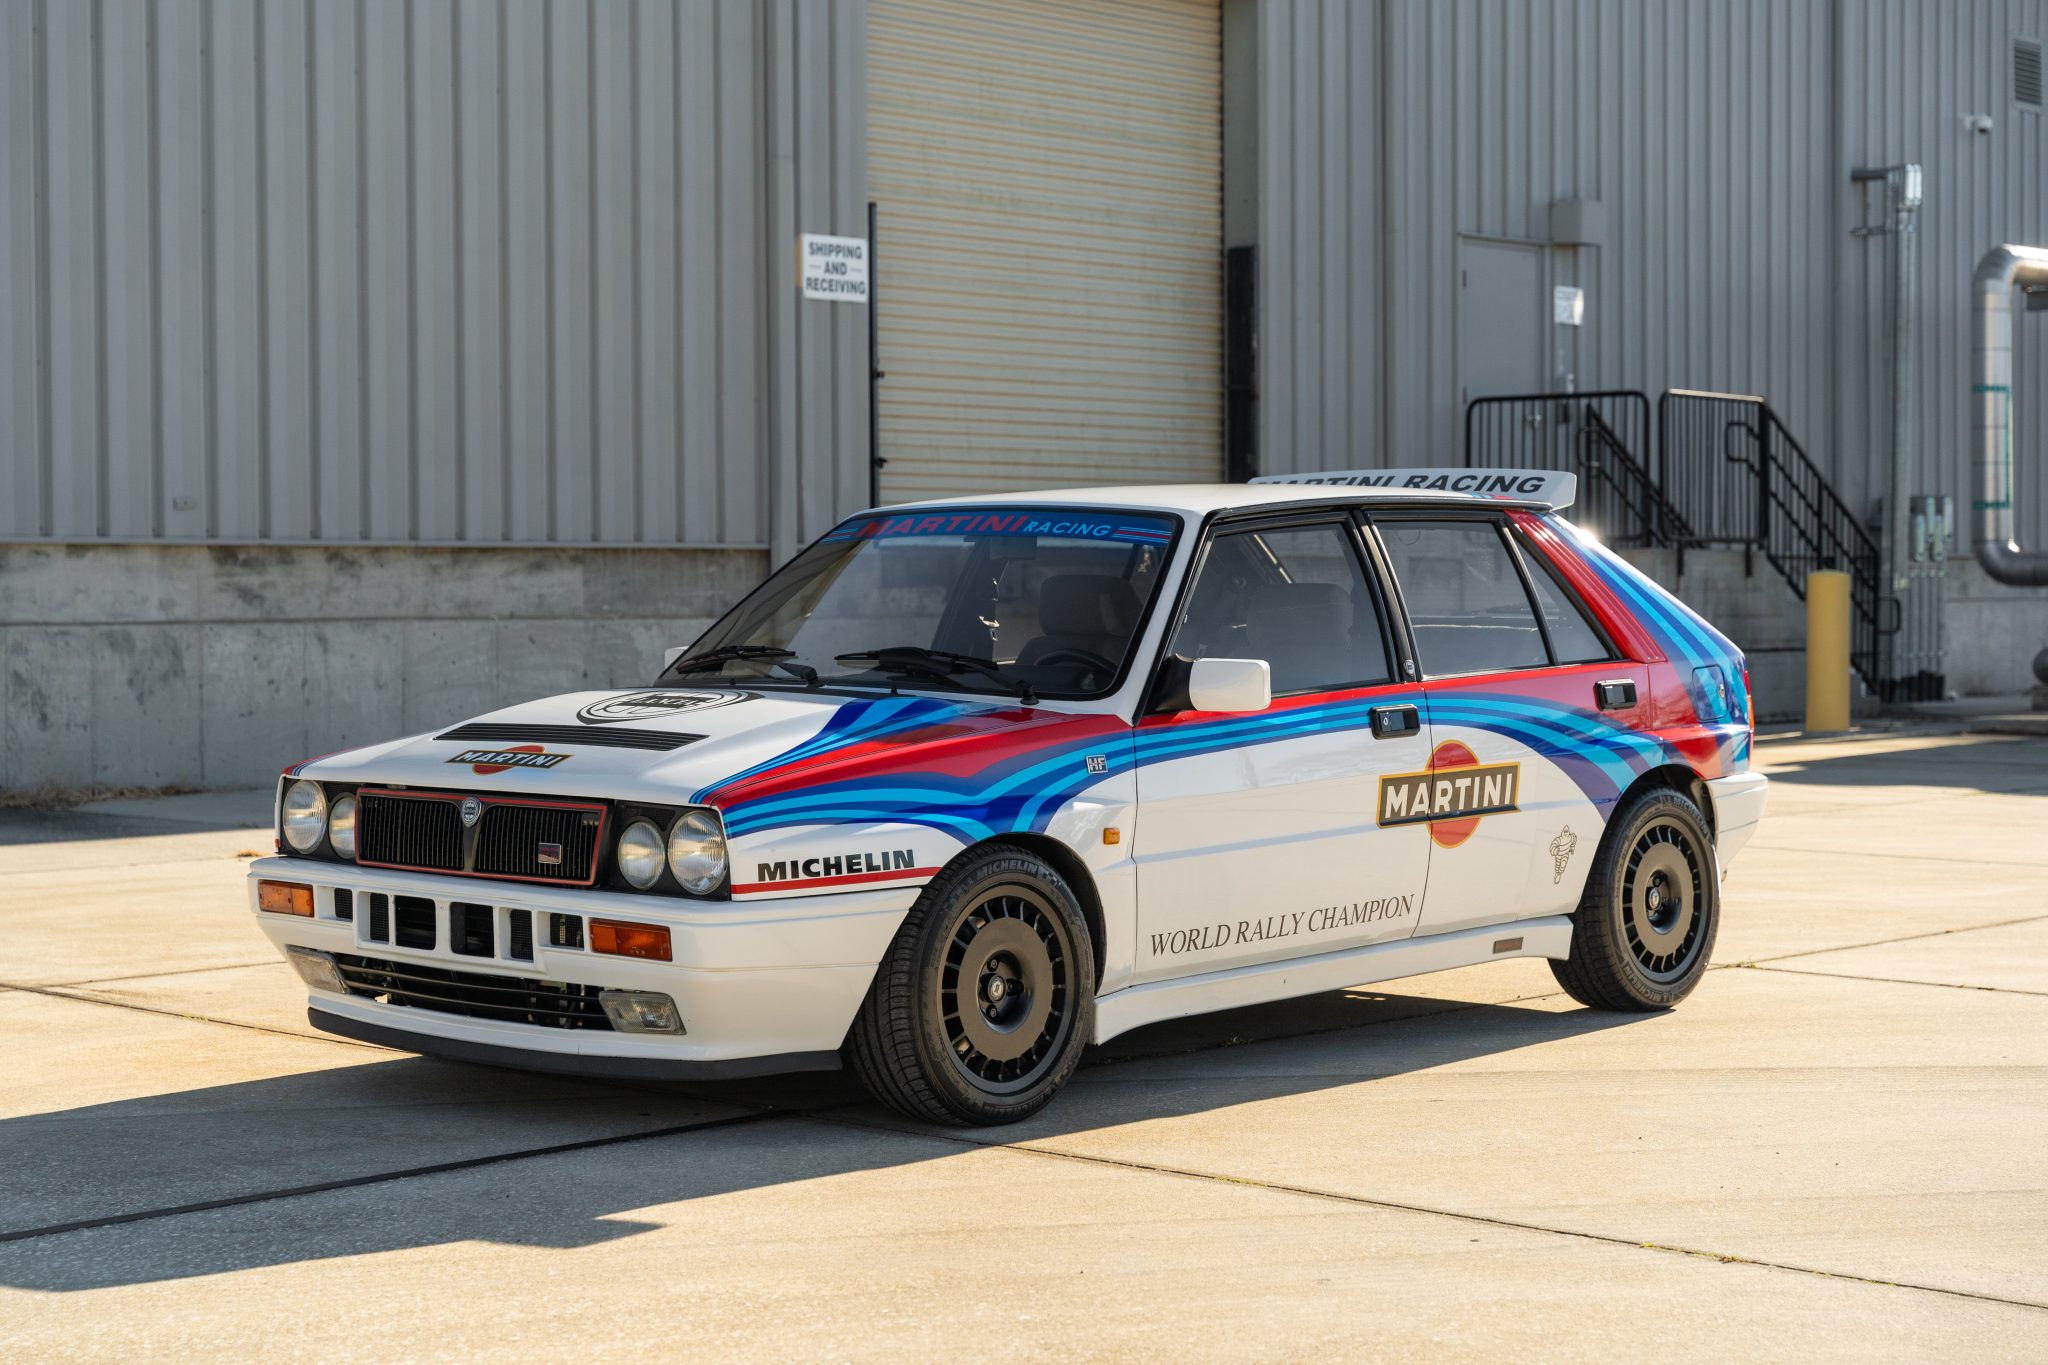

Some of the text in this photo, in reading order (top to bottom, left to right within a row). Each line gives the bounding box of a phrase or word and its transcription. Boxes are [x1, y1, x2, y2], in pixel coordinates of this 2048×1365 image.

[809, 242, 862, 259] SHIPPING
[824, 261, 847, 275] AND
[806, 277, 865, 294] RECEIVING
[1402, 475, 1546, 493] RACING
[856, 515, 1112, 537] MARTINI RACING
[455, 751, 563, 766] MARTINI
[1088, 757, 1105, 770] HF
[1385, 773, 1513, 819] MARTINI
[757, 849, 915, 882] MICHELIN
[976, 859, 1040, 880] MICHELIN
[1151, 894, 1415, 957] WORLD RALLY CHAMPION
[1623, 964, 1662, 1003] MICHELIN
